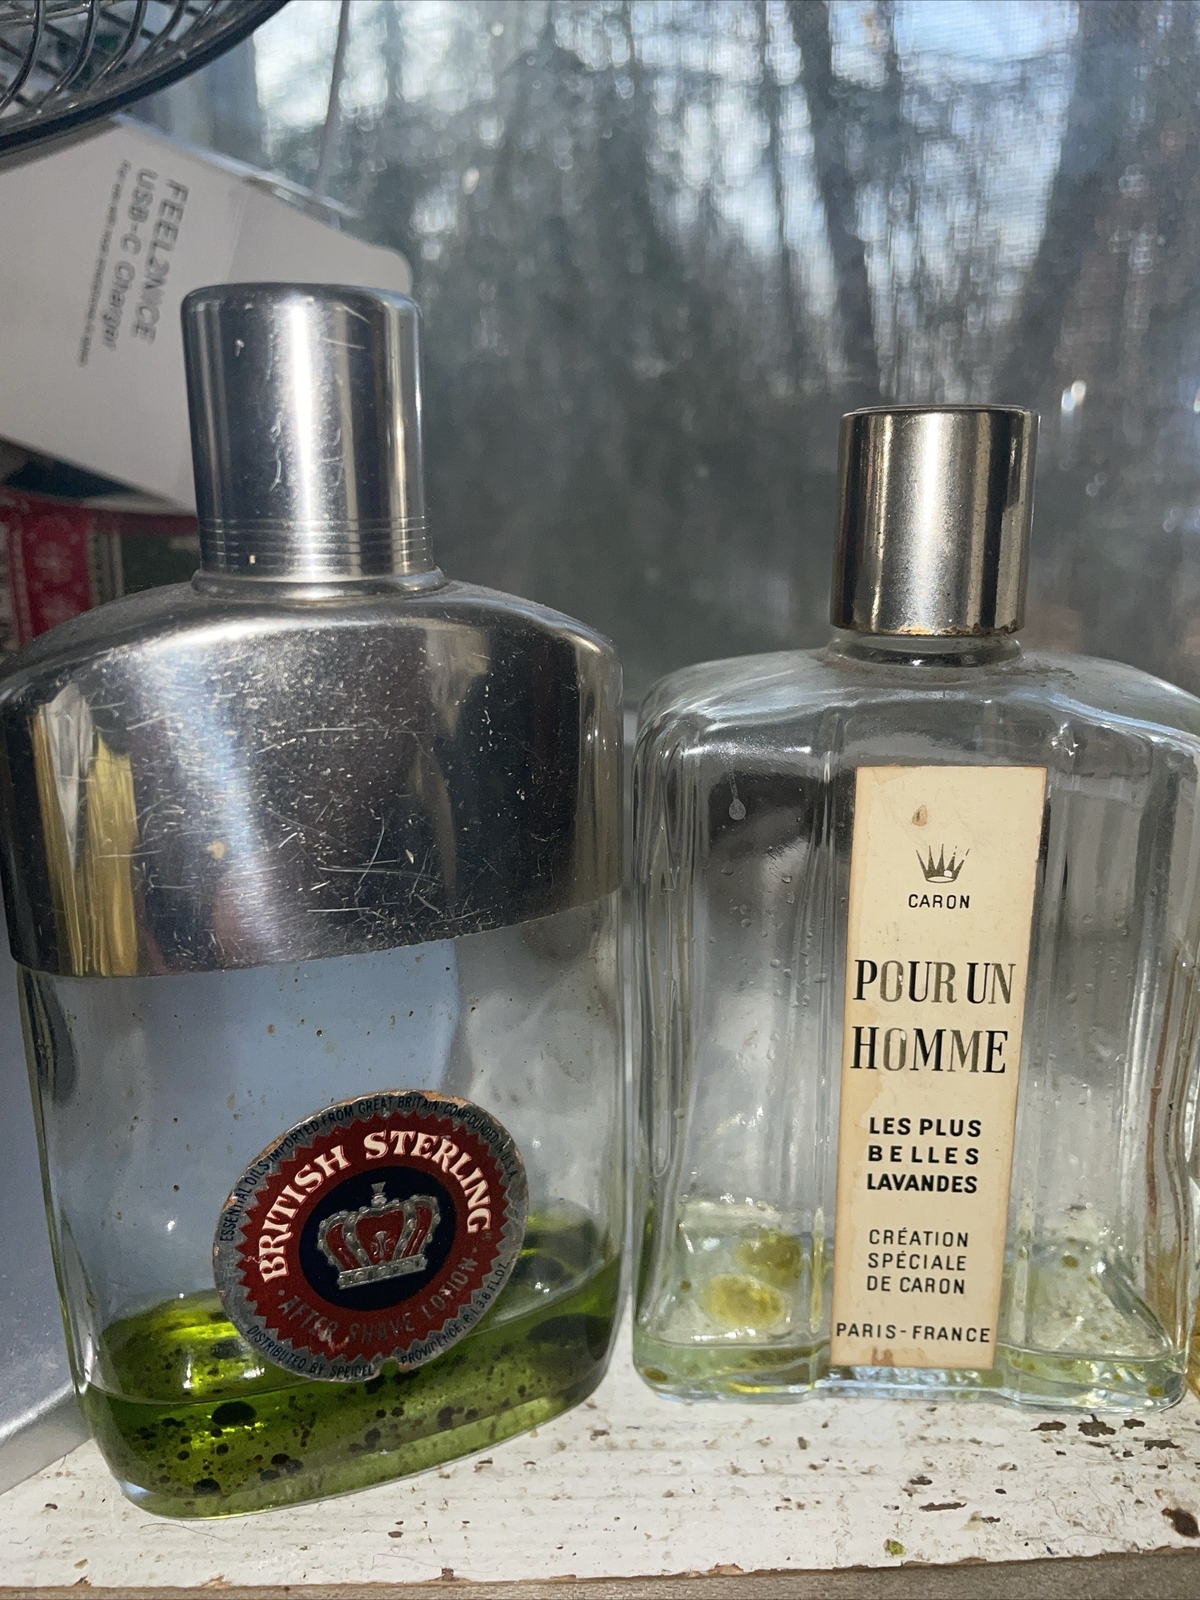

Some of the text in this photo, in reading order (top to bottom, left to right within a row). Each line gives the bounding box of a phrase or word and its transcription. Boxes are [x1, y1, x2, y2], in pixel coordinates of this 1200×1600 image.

[120, 168, 158, 255] USB-C
[908, 894, 970, 909] CARON
[852, 959, 1016, 1005] POUR UN
[850, 1026, 1009, 1074] HOMME
[869, 1116, 982, 1138] LES PLUS
[219, 1187, 253, 1242] ESSENTIAL
[243, 1158, 272, 1187] OILS
[267, 1119, 320, 1164] IMPORTED
[320, 1105, 354, 1128] FROM
[358, 1096, 394, 1115] GREAT
[397, 1095, 438, 1112] BRITAIN
[443, 1103, 500, 1144] COMPOUNDED
[867, 1144, 980, 1165] BELLES
[866, 1172, 978, 1194] LAVANDES
[257, 1129, 492, 1283] BRITISH STERLING
[868, 1226, 969, 1248] CRÉATION
[867, 1250, 967, 1271] SPÉCIALE
[277, 1257, 479, 1345] AFTER SHAVE LOTION
[866, 1275, 966, 1294] DE CARON
[246, 1325, 307, 1370] DISTRIBUTED
[309, 1362, 326, 1375] BY
[329, 1363, 375, 1379] SPEIDEL
